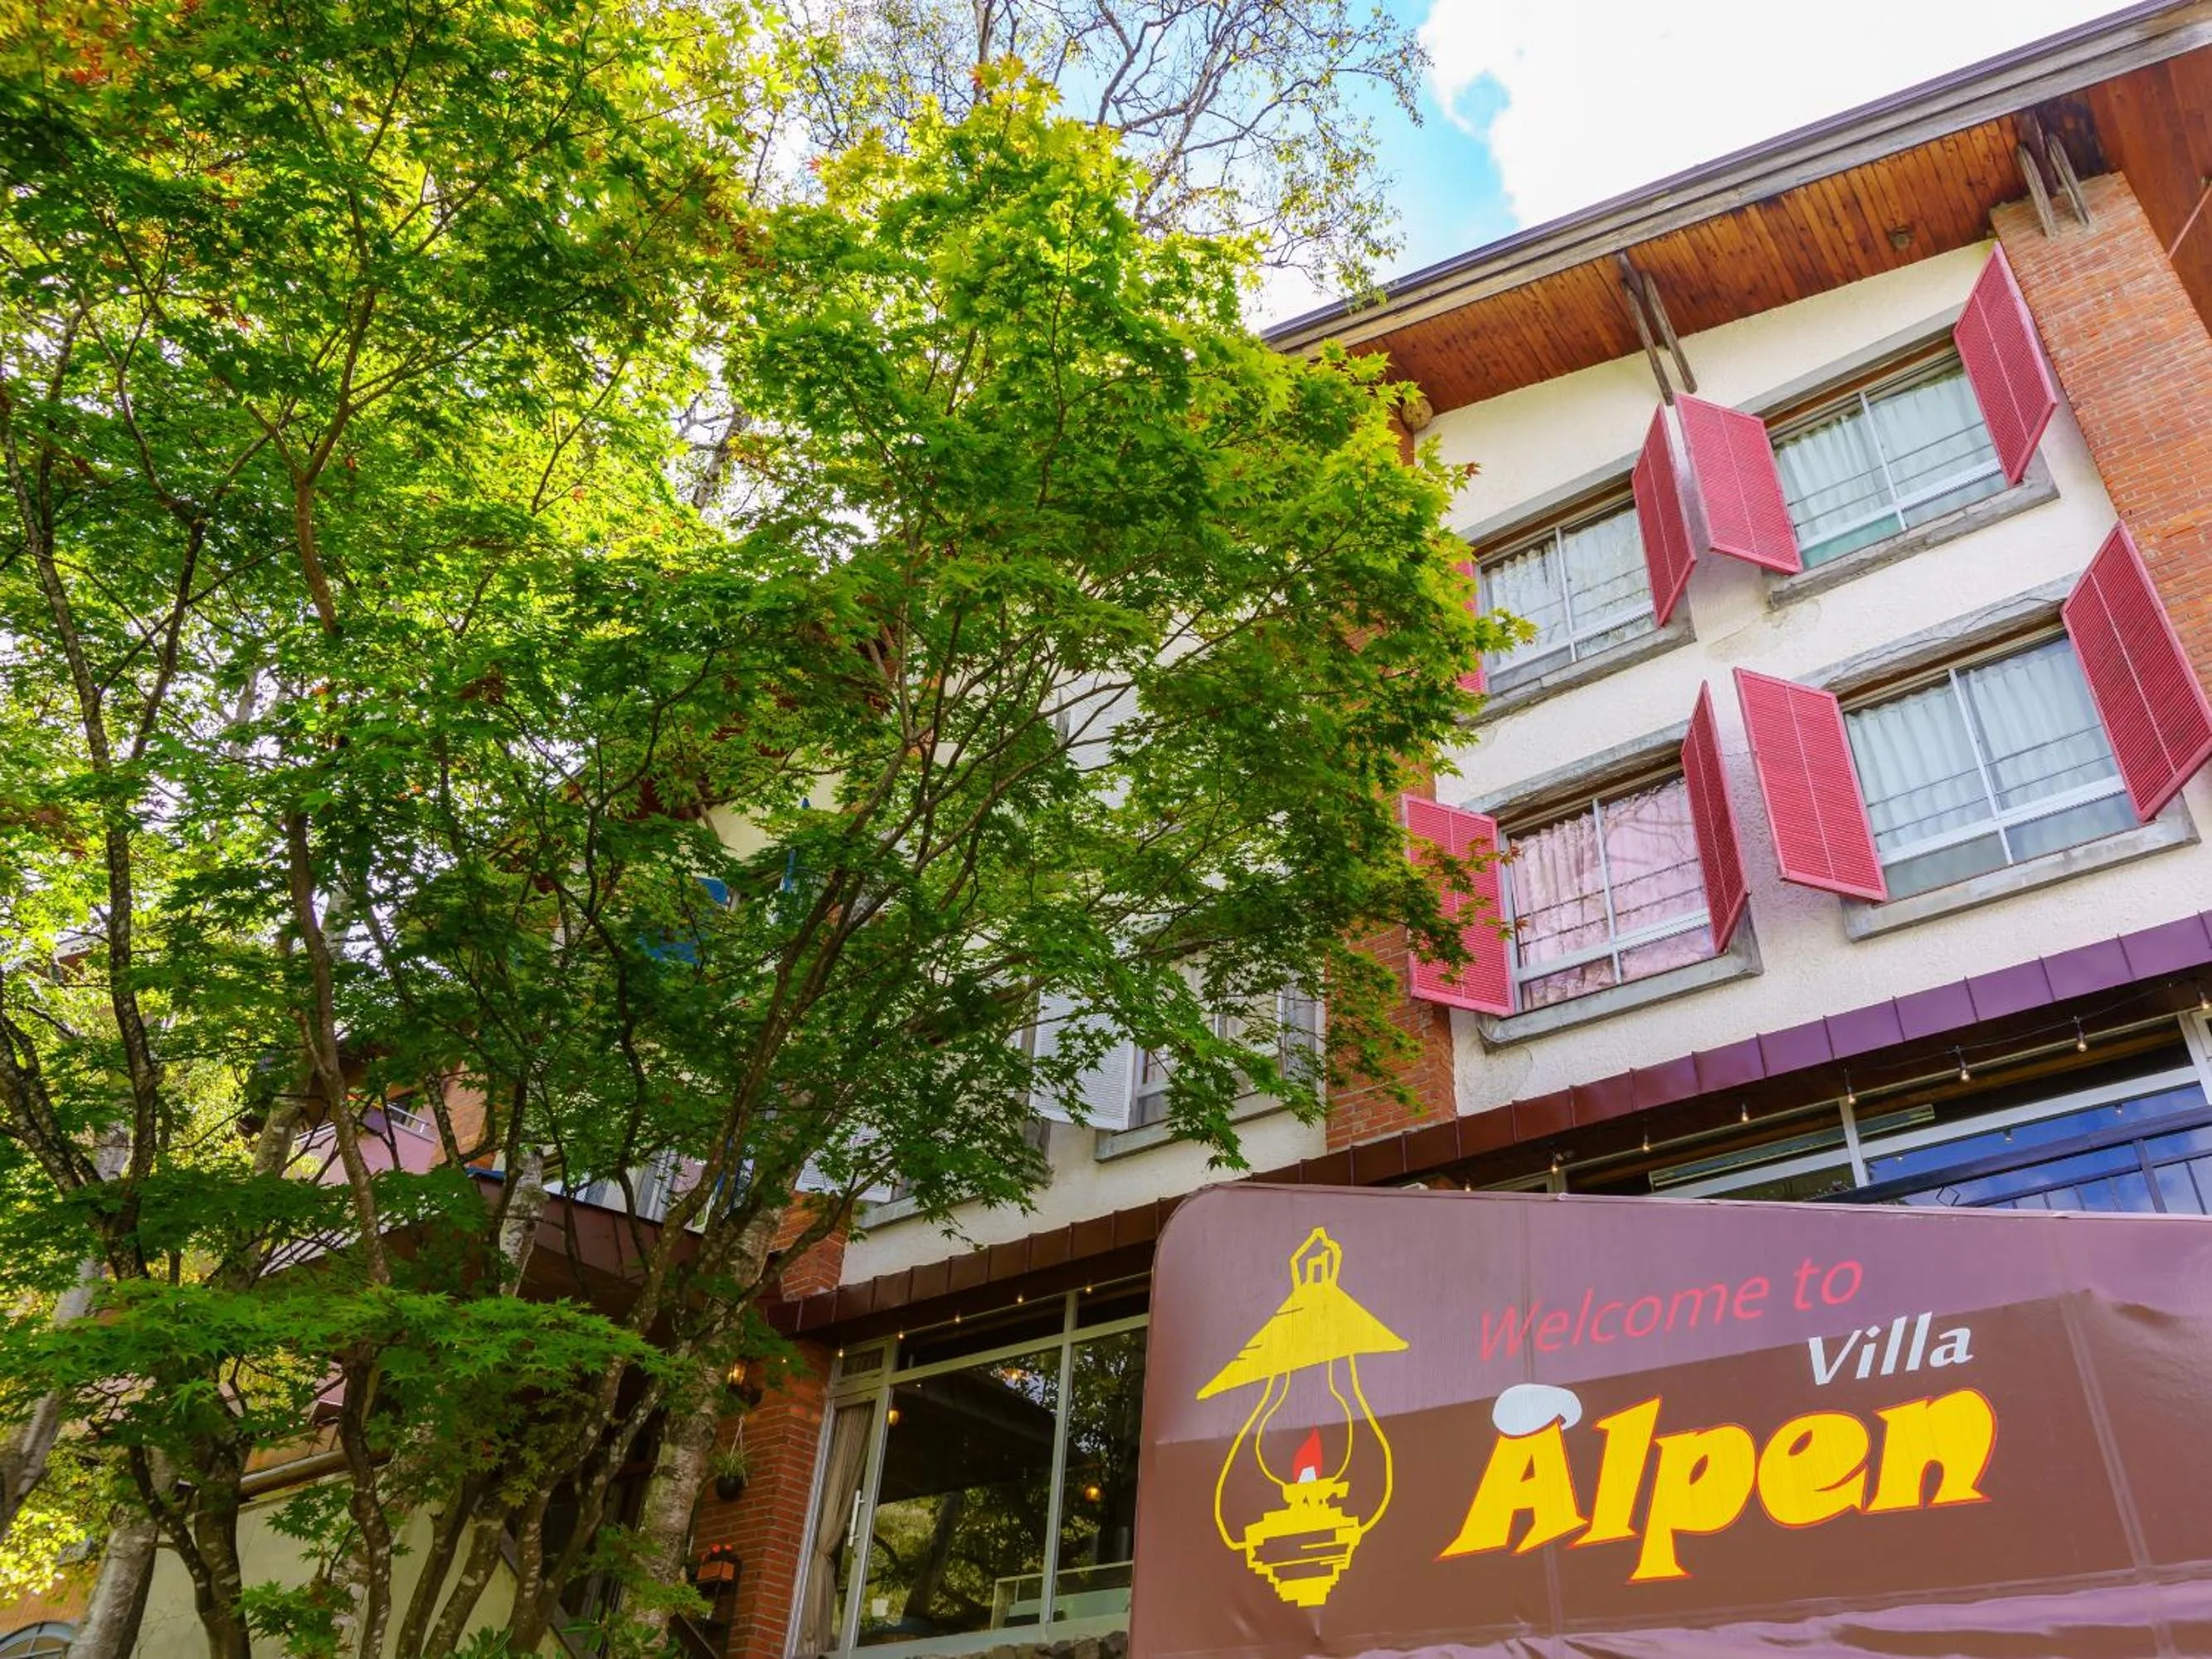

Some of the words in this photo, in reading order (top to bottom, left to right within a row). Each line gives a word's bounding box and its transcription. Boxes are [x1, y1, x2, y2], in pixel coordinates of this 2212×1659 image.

[1480, 1274, 1768, 1361] Welcome
[1792, 1256, 1863, 1311] to
[1807, 1311, 1973, 1385] Villa
[1436, 1385, 1998, 1583] Alpen
